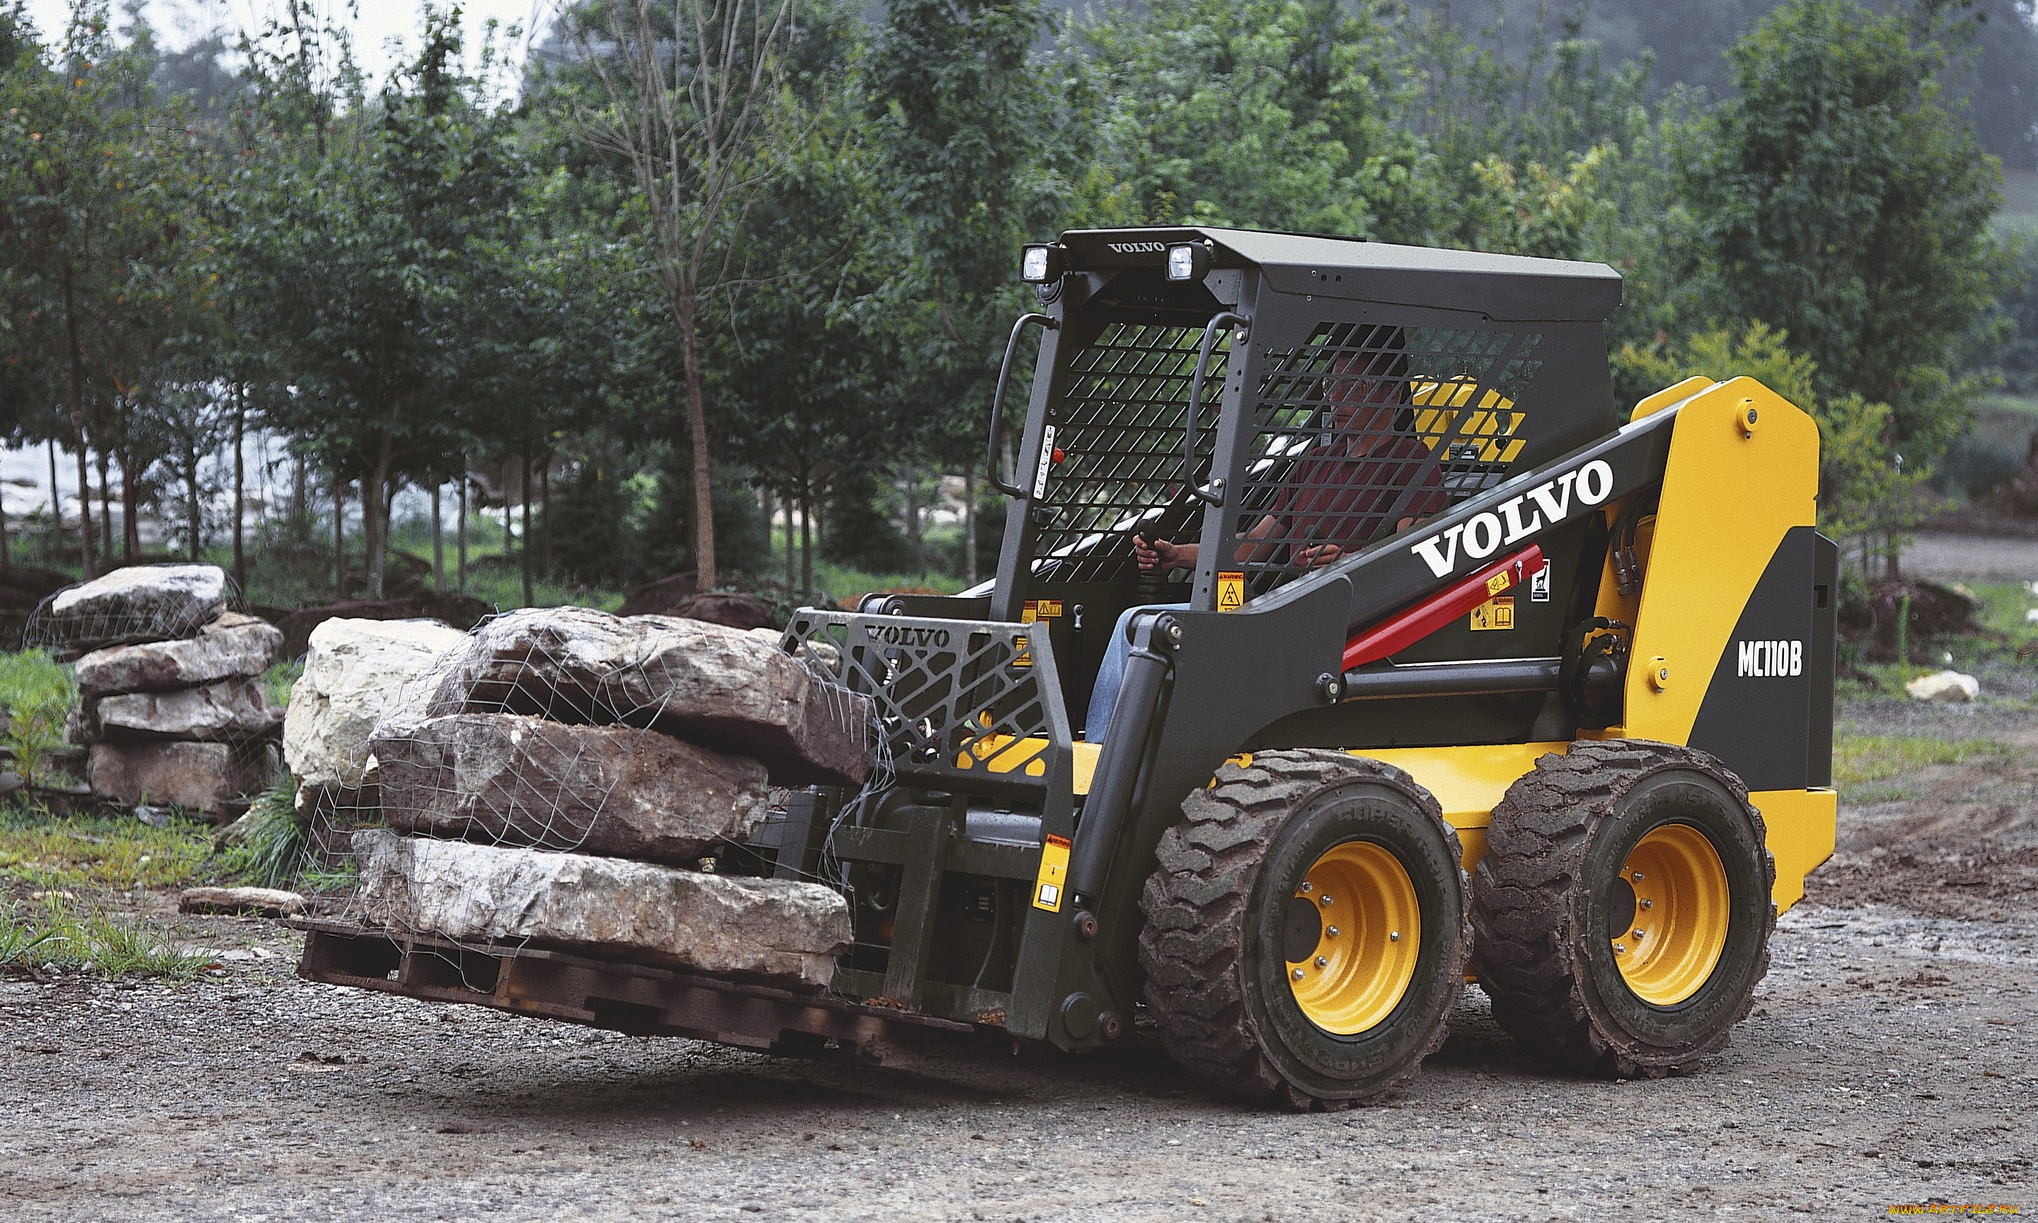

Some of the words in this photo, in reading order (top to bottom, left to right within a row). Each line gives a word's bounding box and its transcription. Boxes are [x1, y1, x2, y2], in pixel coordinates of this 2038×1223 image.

[1107, 241, 1166, 253] VOLVO
[1411, 459, 1614, 579] VOLVO
[864, 624, 950, 648] VOLVO
[1737, 640, 1803, 677] MC110B
